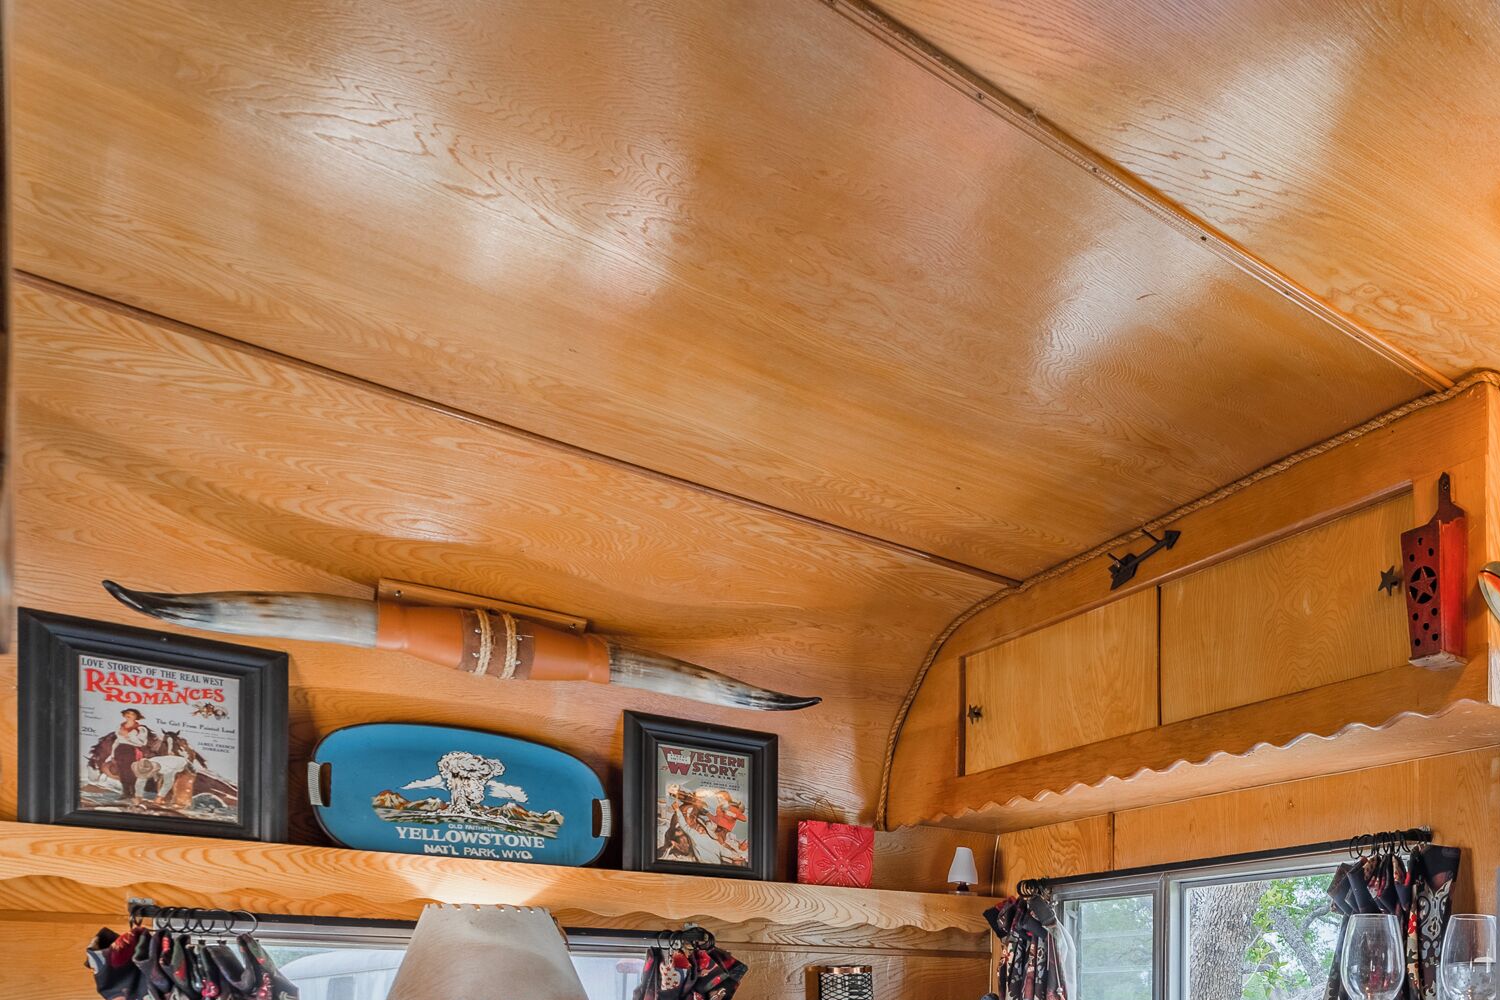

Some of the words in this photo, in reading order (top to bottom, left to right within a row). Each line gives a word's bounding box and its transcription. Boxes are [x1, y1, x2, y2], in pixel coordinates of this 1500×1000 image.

[81, 657, 104, 669] LOVE
[107, 661, 143, 674] STORIES
[145, 666, 156, 676] OF
[160, 669, 176, 680] THE
[179, 672, 200, 683] REAL
[202, 676, 225, 687] WEST
[84, 668, 179, 694] RANCH
[104, 687, 225, 705] ROMANCES
[692, 762, 739, 777] STORY
[464, 824, 497, 832] FAITHFUL
[395, 826, 545, 849] YELLOWSTONE
[423, 844, 459, 856] NAT'L
